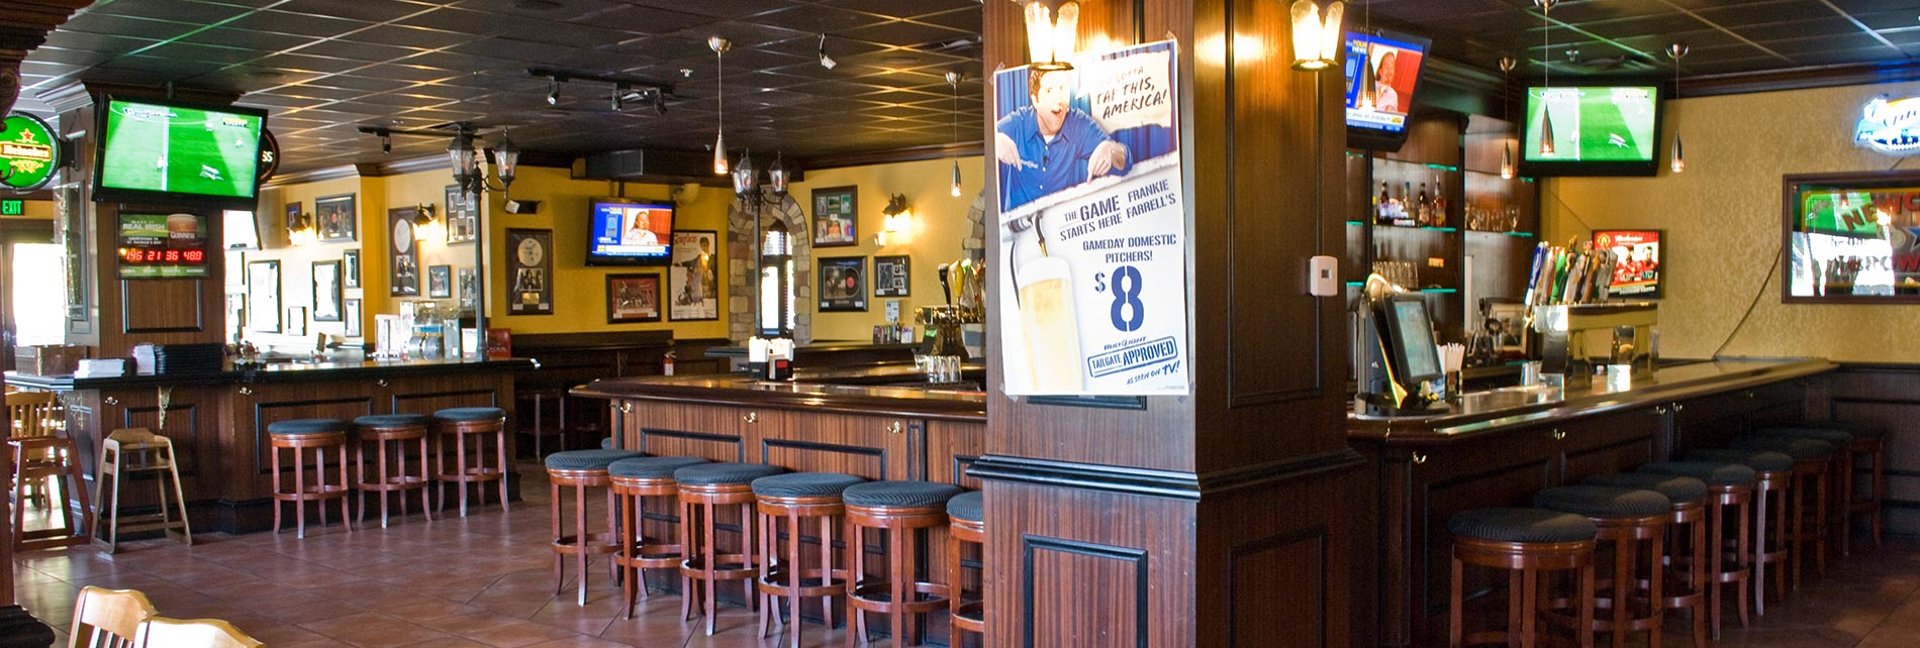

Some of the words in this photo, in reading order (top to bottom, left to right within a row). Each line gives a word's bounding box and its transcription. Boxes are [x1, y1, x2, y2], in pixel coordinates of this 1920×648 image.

[1124, 77, 1155, 95] THIS,
[1102, 89, 1167, 119] AMERICA!
[1127, 179, 1169, 203] FRANKIE
[2, 200, 22, 215] EXIT
[1064, 210, 1078, 222] THE
[1080, 195, 1121, 221] GAME
[1126, 193, 1176, 218] FARRELL'S
[1060, 221, 1096, 241] STARTS
[1098, 213, 1123, 229] HERE
[1083, 238, 1125, 251] GAMEDAY
[1128, 234, 1177, 248] DOMESTIC
[147, 250, 161, 261] 21
[165, 250, 179, 261] 36
[1105, 250, 1153, 264] PITCHERS!
[1092, 354, 1122, 370] TAILGATE
[1123, 340, 1175, 366] APPROVED
[1151, 368, 1160, 377] ON
[1162, 360, 1180, 376] TV!
